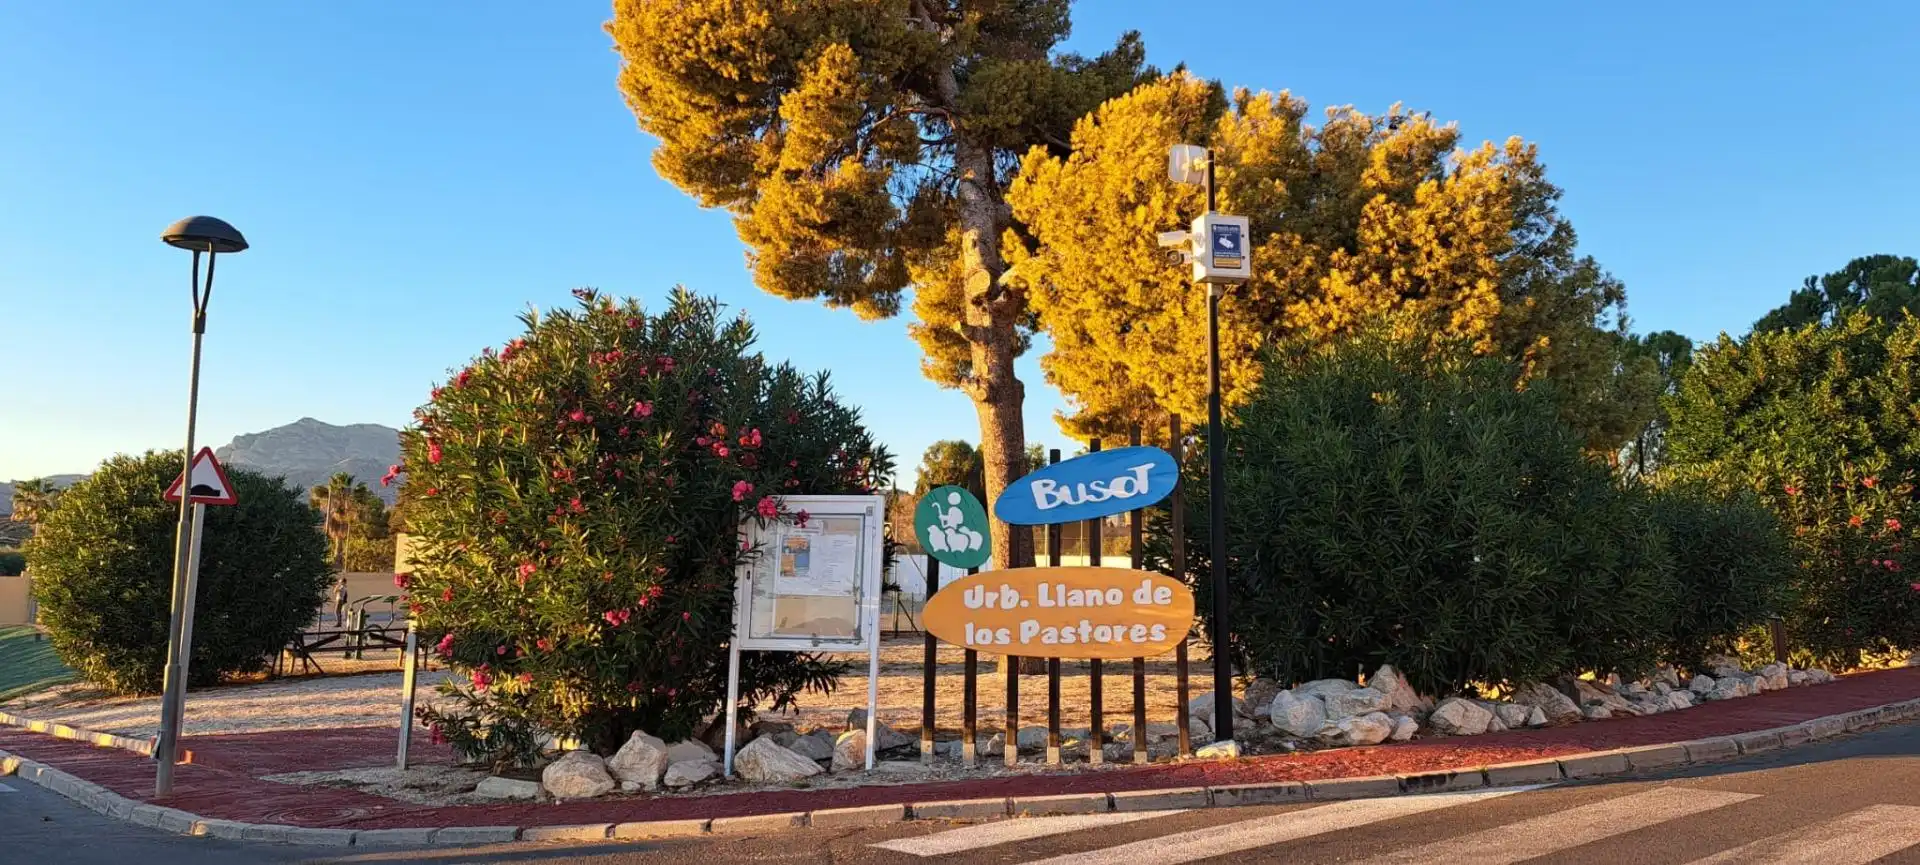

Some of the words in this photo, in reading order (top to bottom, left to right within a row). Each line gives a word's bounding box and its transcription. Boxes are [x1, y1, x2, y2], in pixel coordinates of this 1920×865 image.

[963, 584, 1029, 609] Urb.
[1038, 583, 1123, 607] Llano
[1132, 580, 1172, 605] de
[965, 622, 1010, 645] los
[1020, 620, 1166, 644] Pastores
